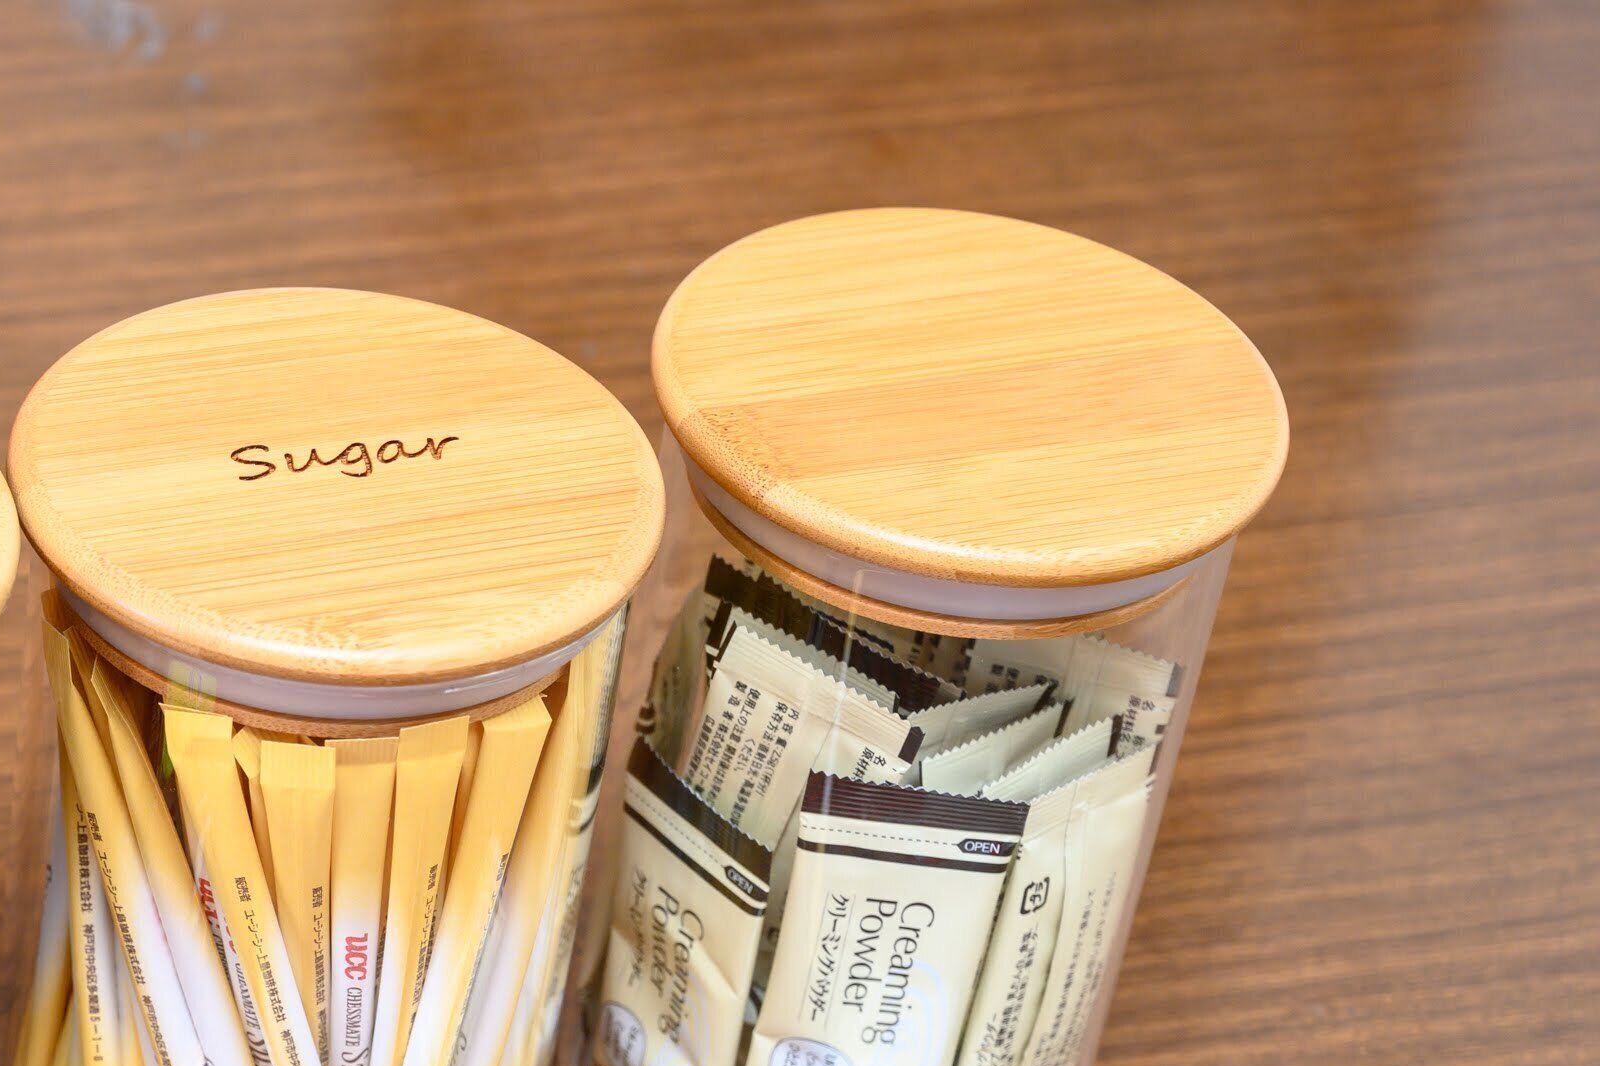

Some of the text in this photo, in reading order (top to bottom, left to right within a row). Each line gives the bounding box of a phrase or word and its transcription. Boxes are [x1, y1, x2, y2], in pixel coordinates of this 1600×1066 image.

[230, 436, 459, 481] Sugar
[963, 839, 1002, 855] OPEN
[660, 910, 701, 1045] Creaming
[842, 896, 899, 1014] Powder
[862, 901, 937, 1048] Creaming
[346, 987, 362, 1046] CHESSMATE
